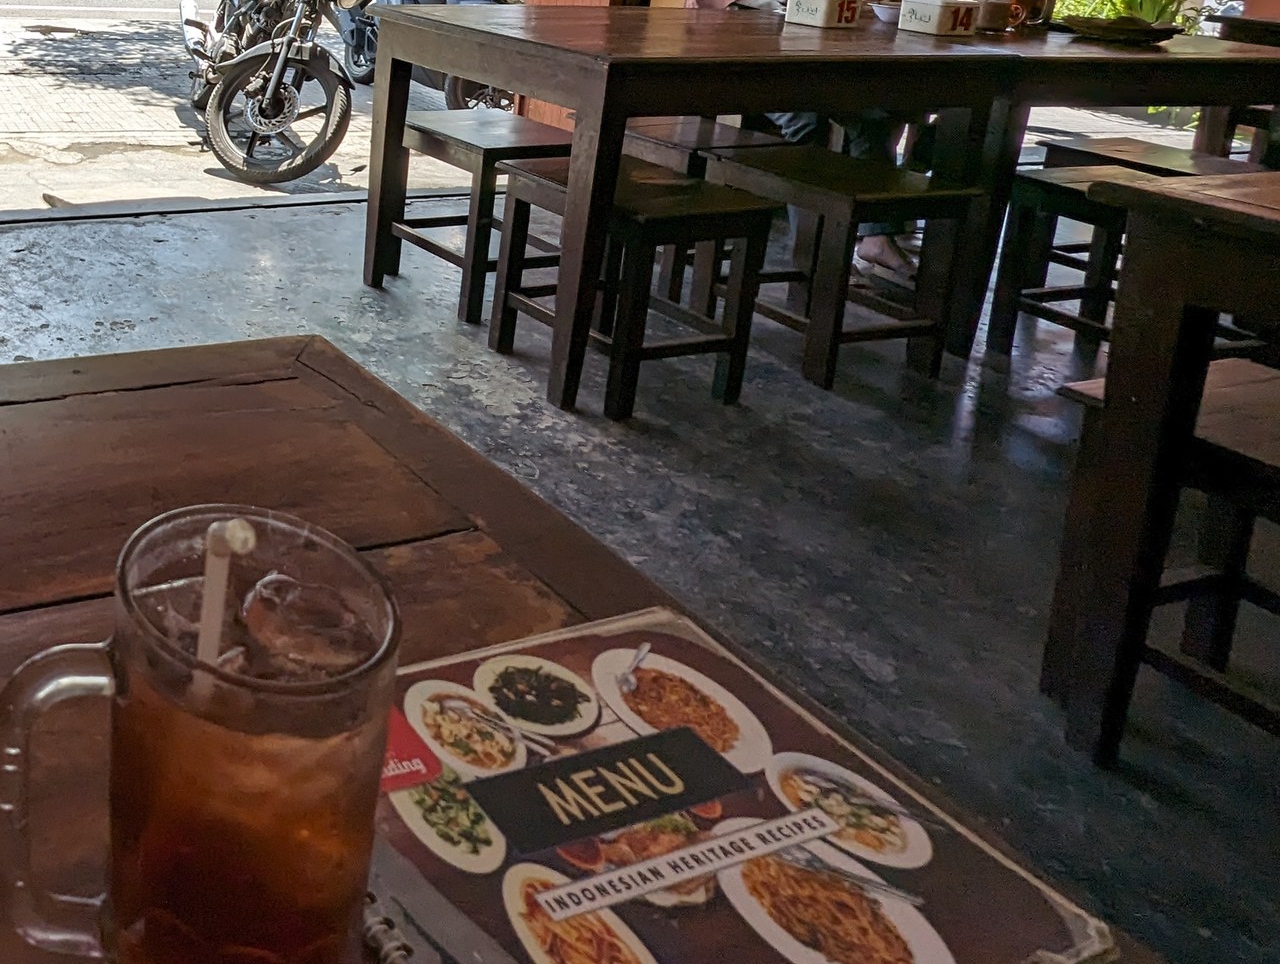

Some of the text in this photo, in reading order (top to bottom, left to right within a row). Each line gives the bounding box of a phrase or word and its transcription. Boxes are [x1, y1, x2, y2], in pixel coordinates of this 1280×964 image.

[837, 0, 857, 24] 15
[951, 6, 974, 31] 14
[537, 753, 685, 825] MENU
[544, 815, 828, 913] INDONESIAN HERITAGE RECIPES
